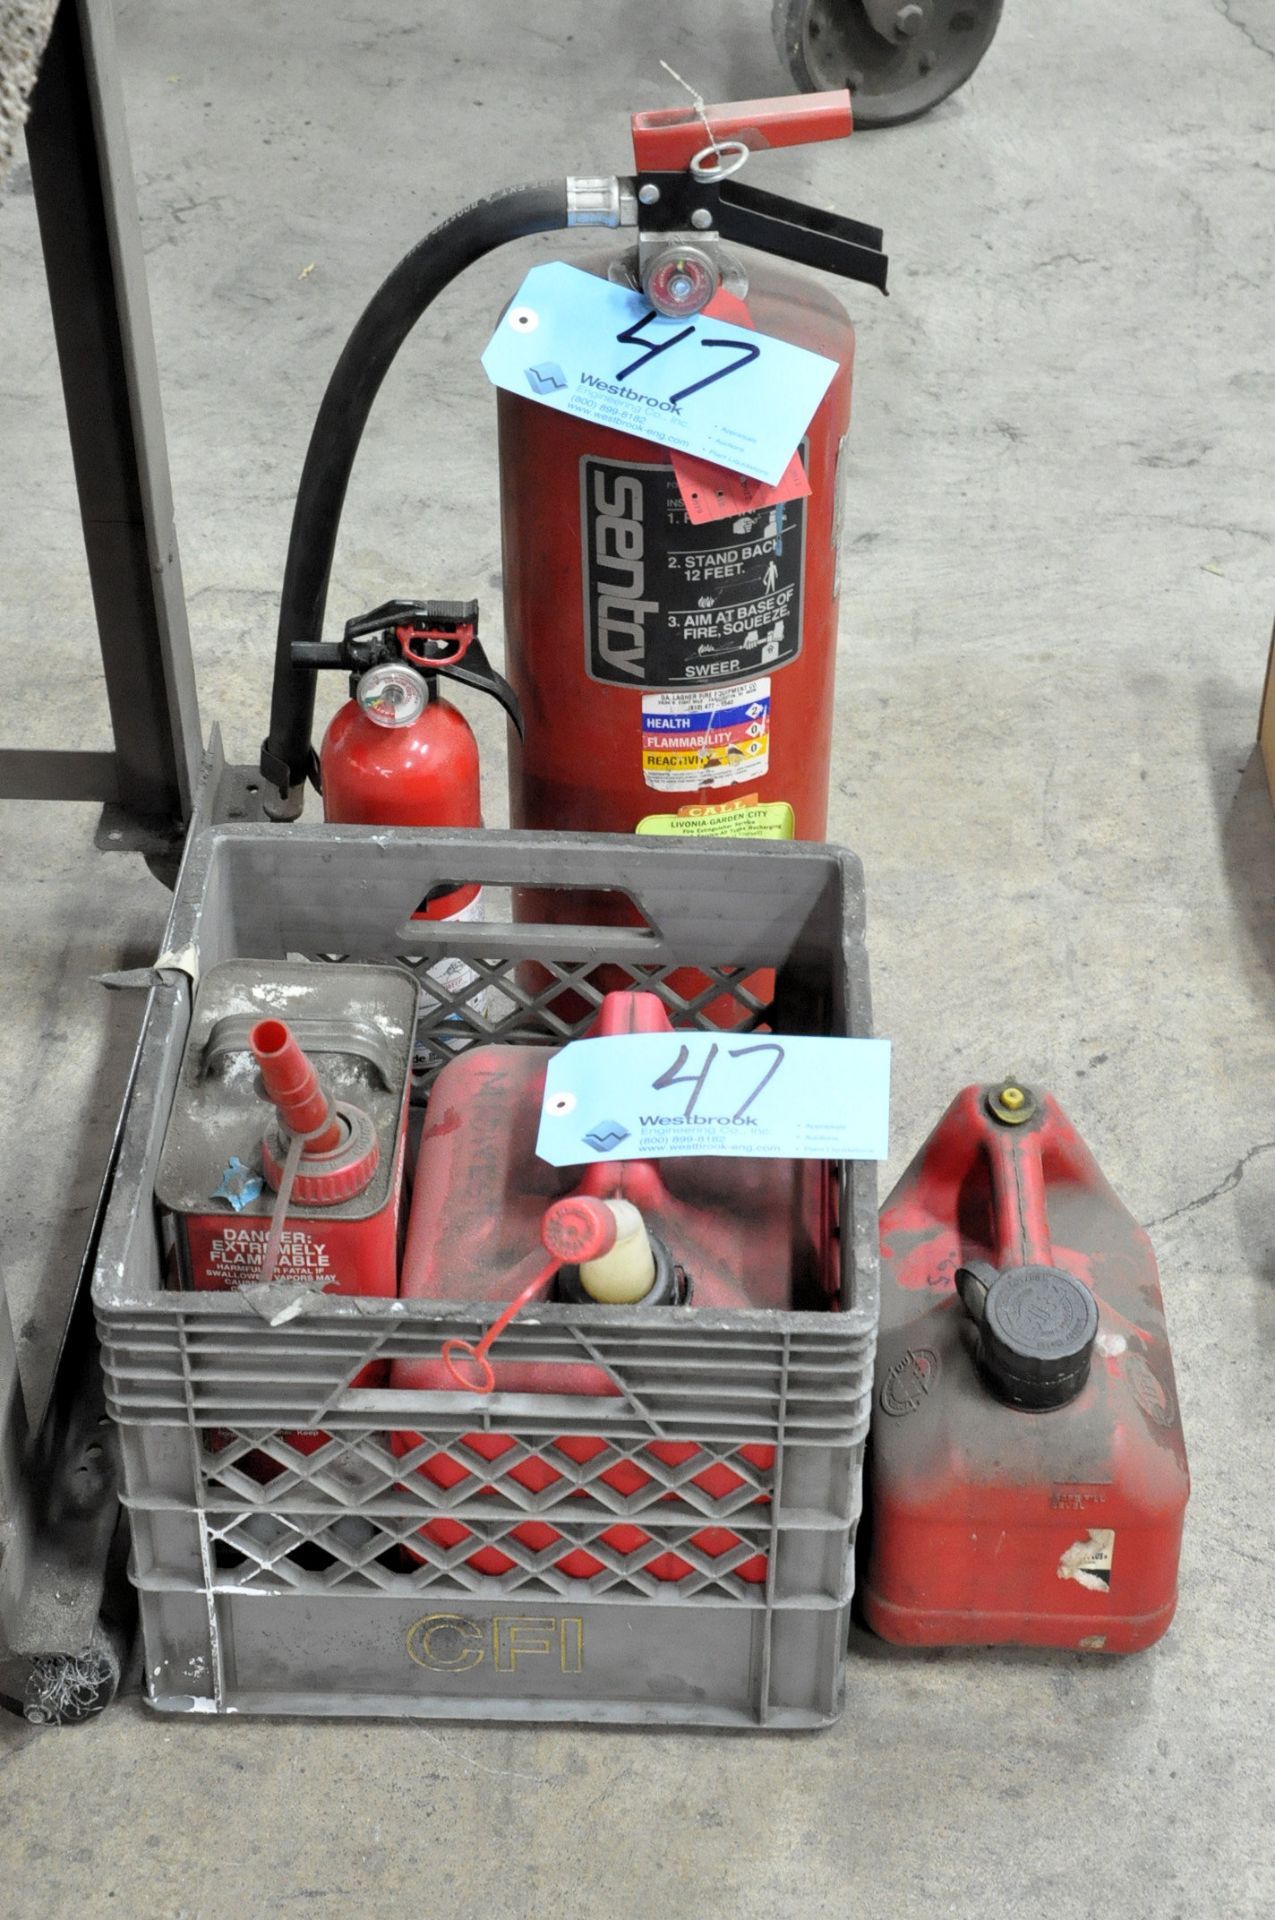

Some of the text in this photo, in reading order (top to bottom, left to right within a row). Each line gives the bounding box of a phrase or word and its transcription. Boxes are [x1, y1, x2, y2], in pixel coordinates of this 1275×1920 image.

[615, 310, 761, 405] 47
[570, 394, 598, 410] (800)
[580, 371, 684, 416] Westbrook
[567, 402, 691, 448] www.westbrook-eng.com
[668, 557, 681, 569] 2.
[684, 551, 738, 569] STAND
[684, 562, 746, 582] 12 FEET.
[668, 588, 795, 628] 3. AIM AT BASE OF
[683, 626, 721, 640] FIRE,
[646, 706, 759, 729] HEALTH 2
[646, 725, 758, 749] FLAMMABILITY 0
[750, 742, 758, 753] 0
[688, 800, 747, 818] CALL
[747, 810, 768, 819] CITY
[652, 1042, 785, 1120] 47
[639, 1114, 758, 1127] Westbrook
[640, 1126, 717, 1137] Engineering
[209, 1251, 331, 1268] FLAMABLE
[315, 1267, 325, 1275] IF
[315, 1274, 337, 1282] MAY
[405, 1611, 584, 1673] CFI
